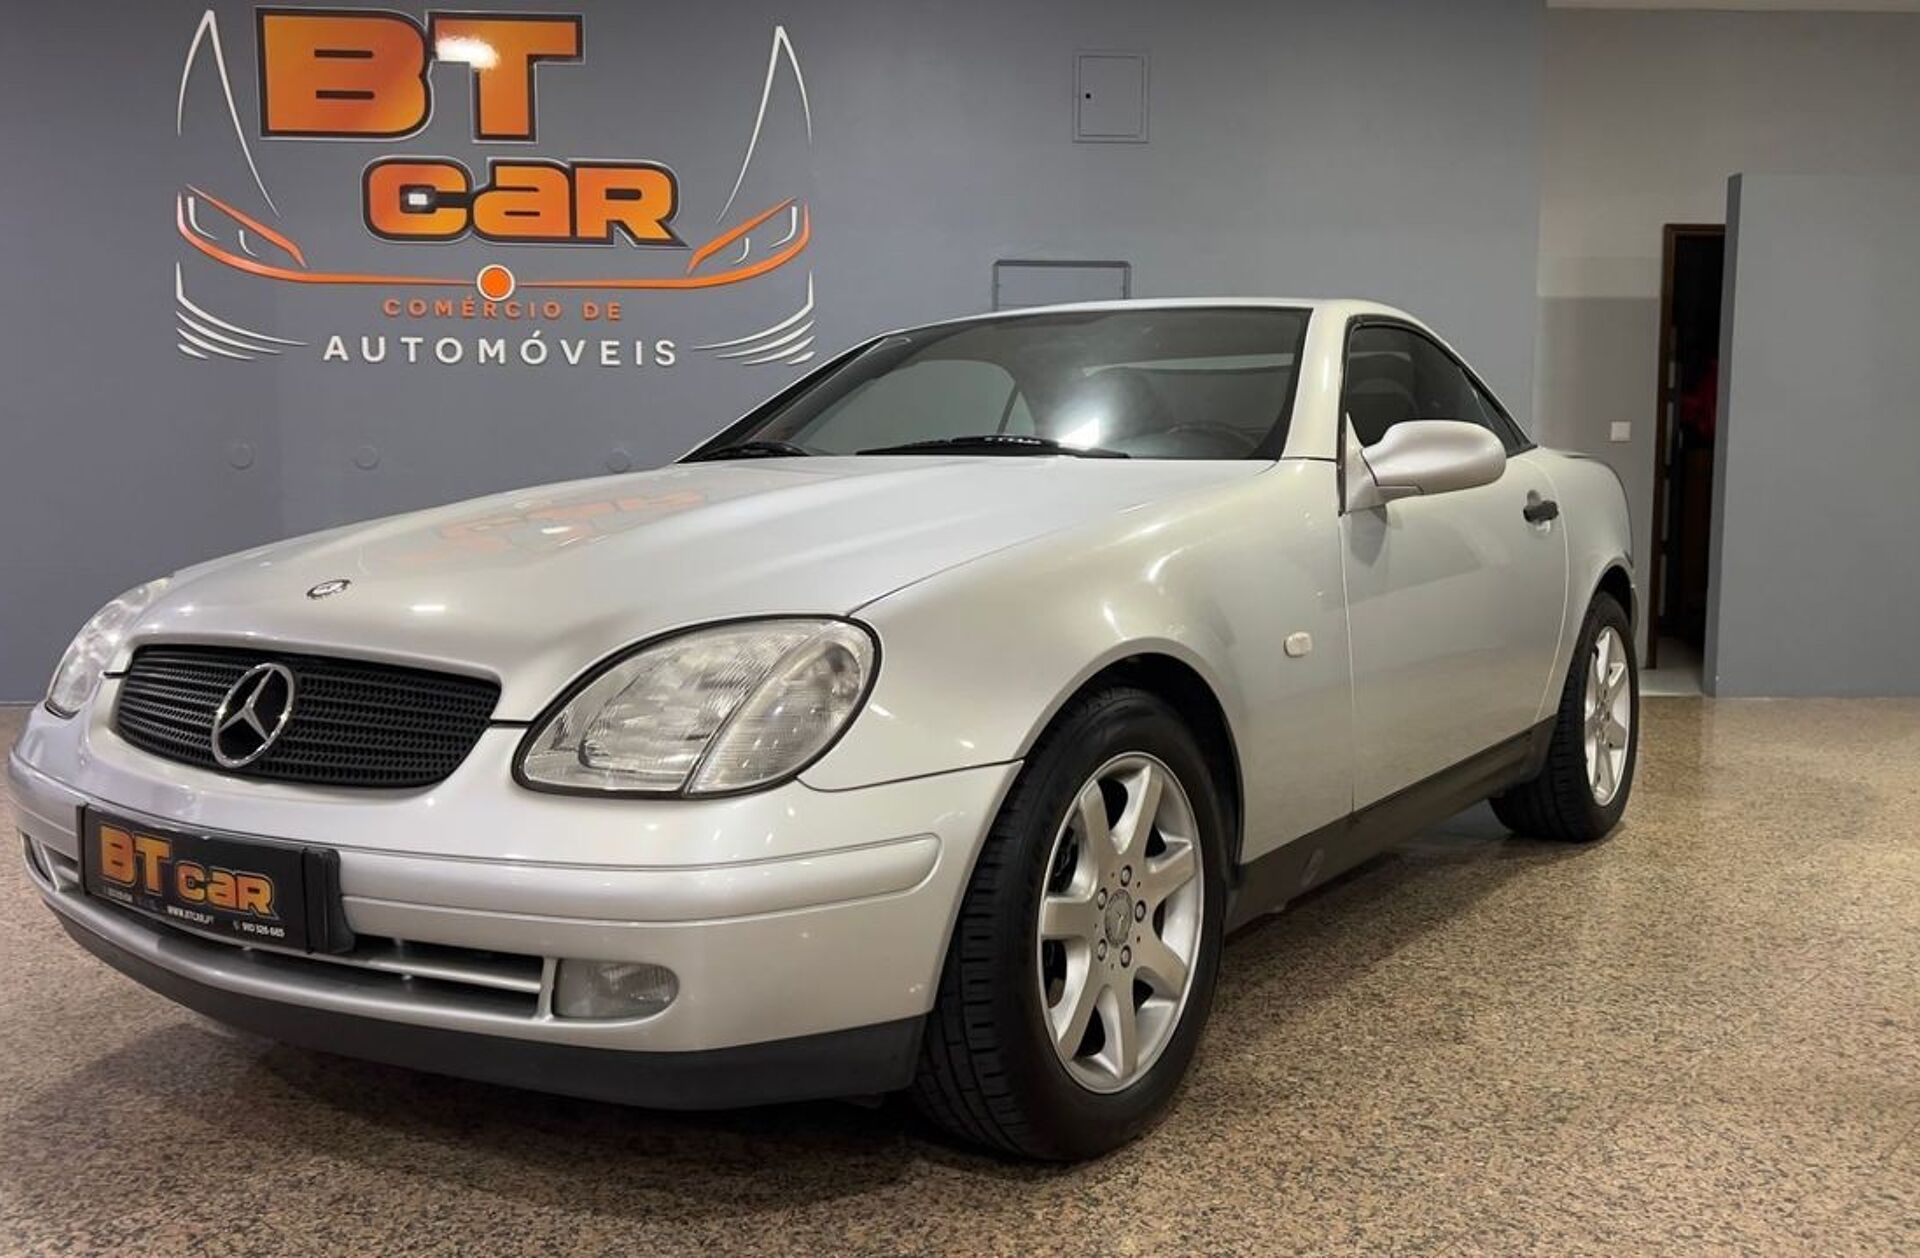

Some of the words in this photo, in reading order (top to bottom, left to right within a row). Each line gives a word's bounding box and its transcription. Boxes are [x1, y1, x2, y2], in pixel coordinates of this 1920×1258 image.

[256, 8, 583, 142] BT
[382, 297, 562, 320] COMÉRCIO
[582, 301, 622, 321] DE
[322, 331, 677, 367] AUTOMÓVEIS
[100, 824, 171, 895] BT
